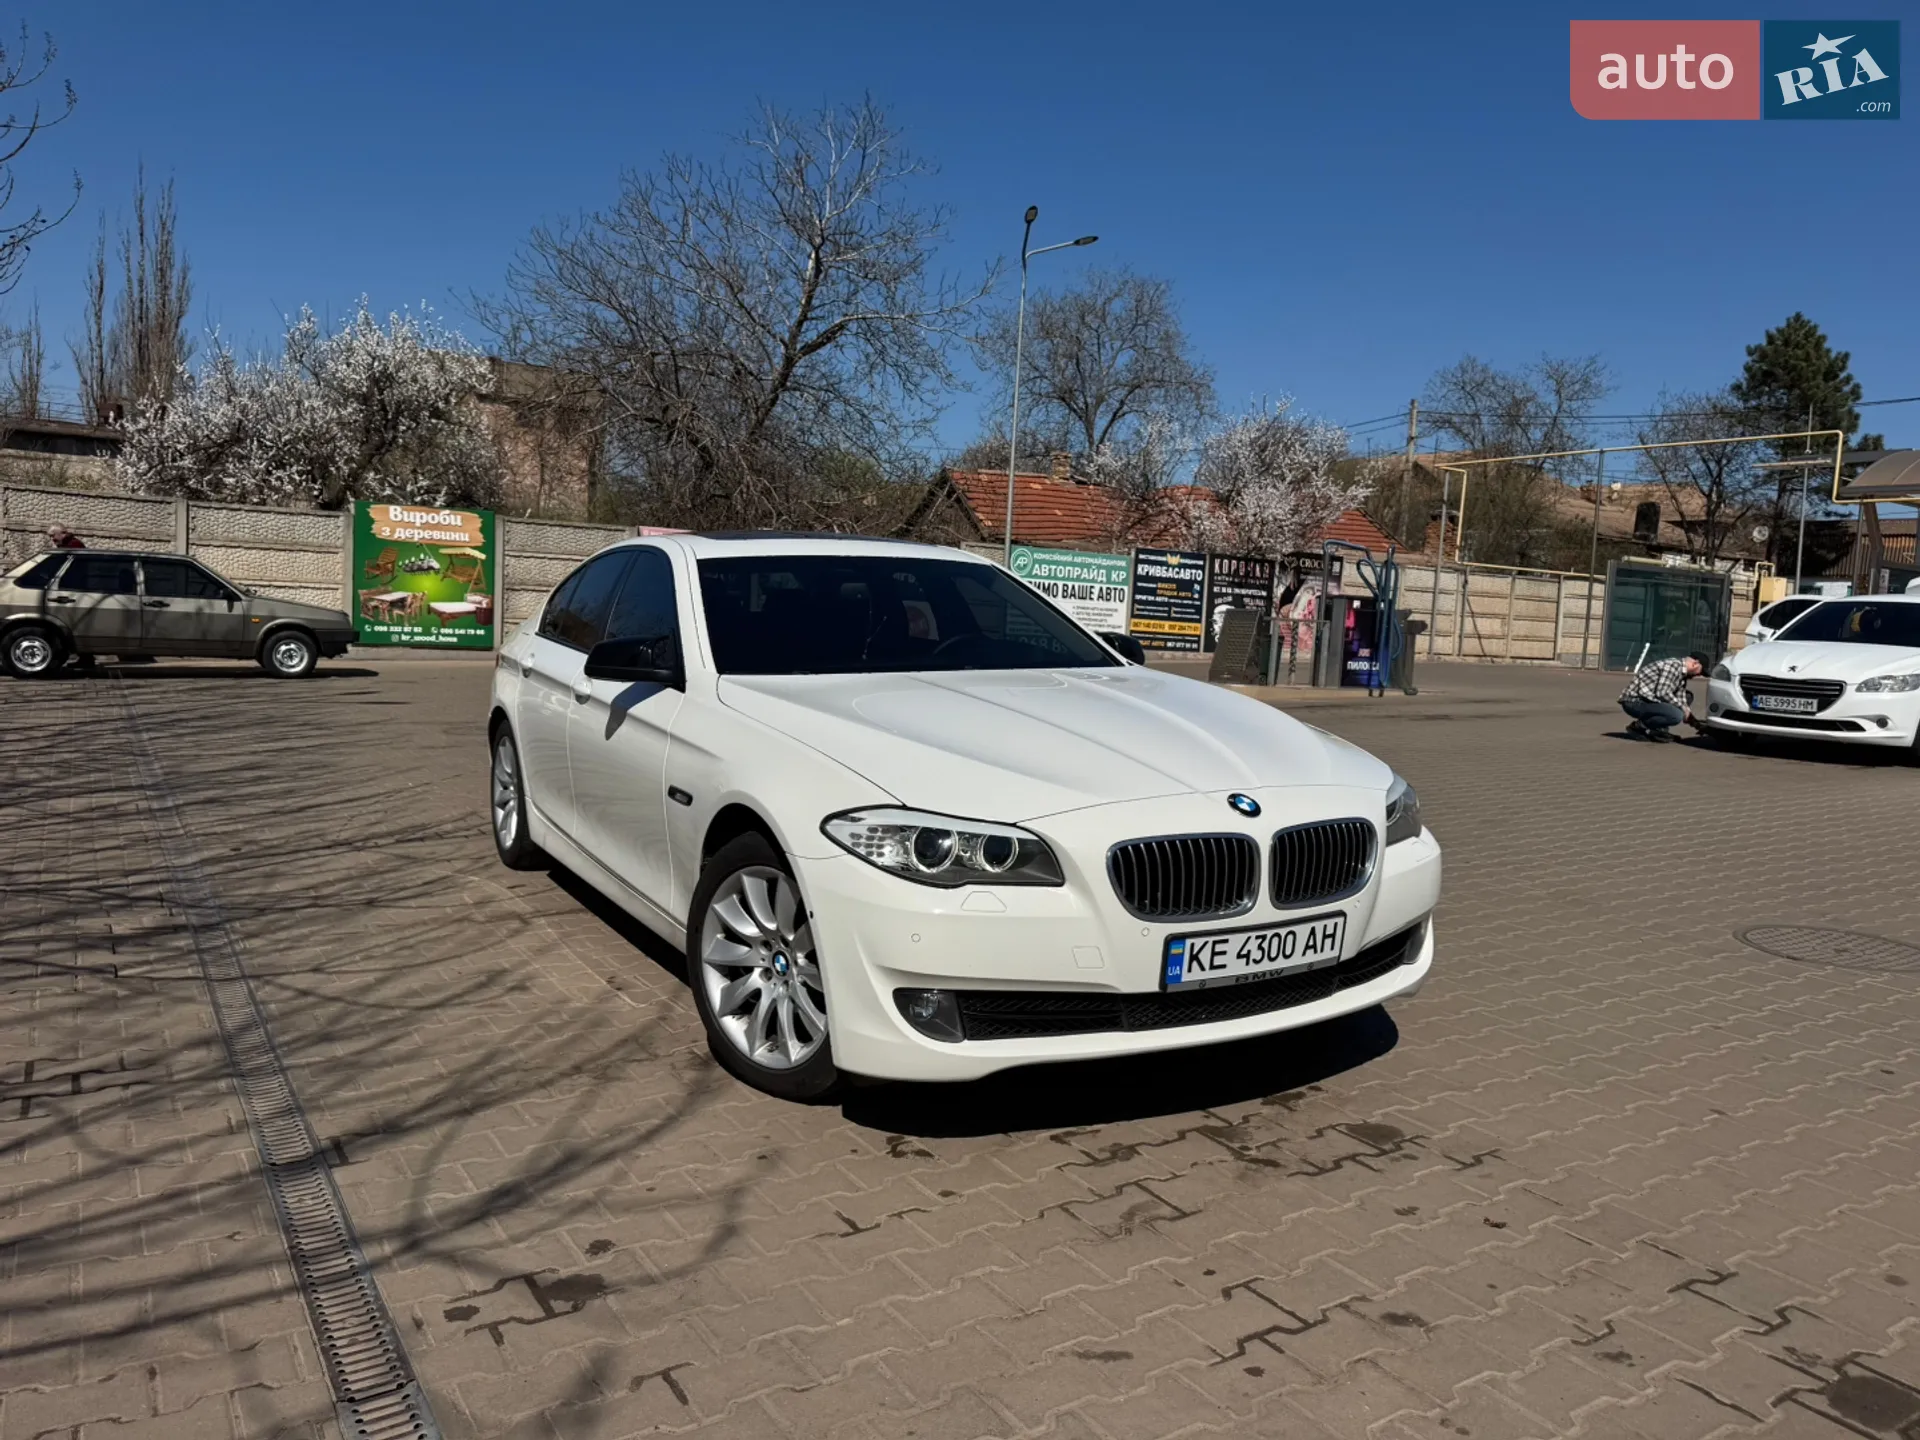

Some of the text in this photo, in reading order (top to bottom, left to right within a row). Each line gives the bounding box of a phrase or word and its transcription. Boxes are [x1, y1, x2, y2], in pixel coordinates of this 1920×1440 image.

[388, 505, 463, 527] Вироби
[381, 526, 470, 542] з деревини
[1032, 563, 1127, 583] АВТОПРАЙД КР
[1136, 563, 1203, 582] КРИВБАСАВТО
[1027, 580, 1126, 603] ИМО ВАШЕ АВТО
[1758, 696, 1771, 707] AE
[1773, 697, 1797, 709] 5995
[1187, 922, 1338, 973] KE 4300 AH
[1167, 966, 1181, 976] UA
